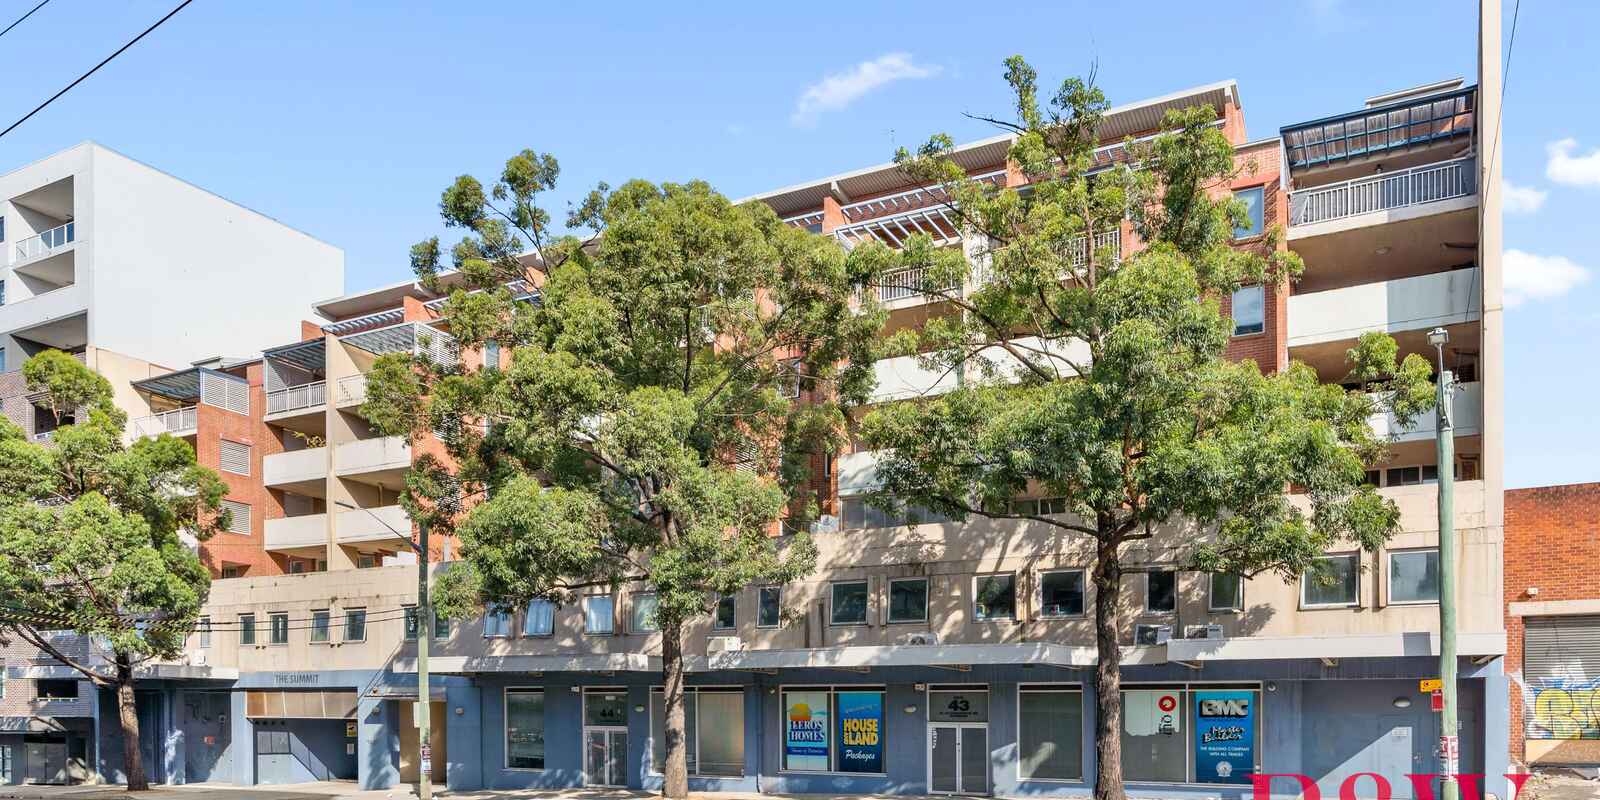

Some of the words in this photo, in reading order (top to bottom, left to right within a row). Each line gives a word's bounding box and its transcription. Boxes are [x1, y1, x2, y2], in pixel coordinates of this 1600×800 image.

[275, 674, 289, 684] THE
[290, 674, 319, 684] SUMMIT
[948, 700, 969, 711] 43
[1200, 700, 1248, 716] BMC
[791, 720, 823, 730] LEROS
[843, 719, 878, 732] HOUSE
[790, 731, 825, 741] HOMES
[848, 732, 878, 745] LAND
[845, 749, 875, 761] Packages
